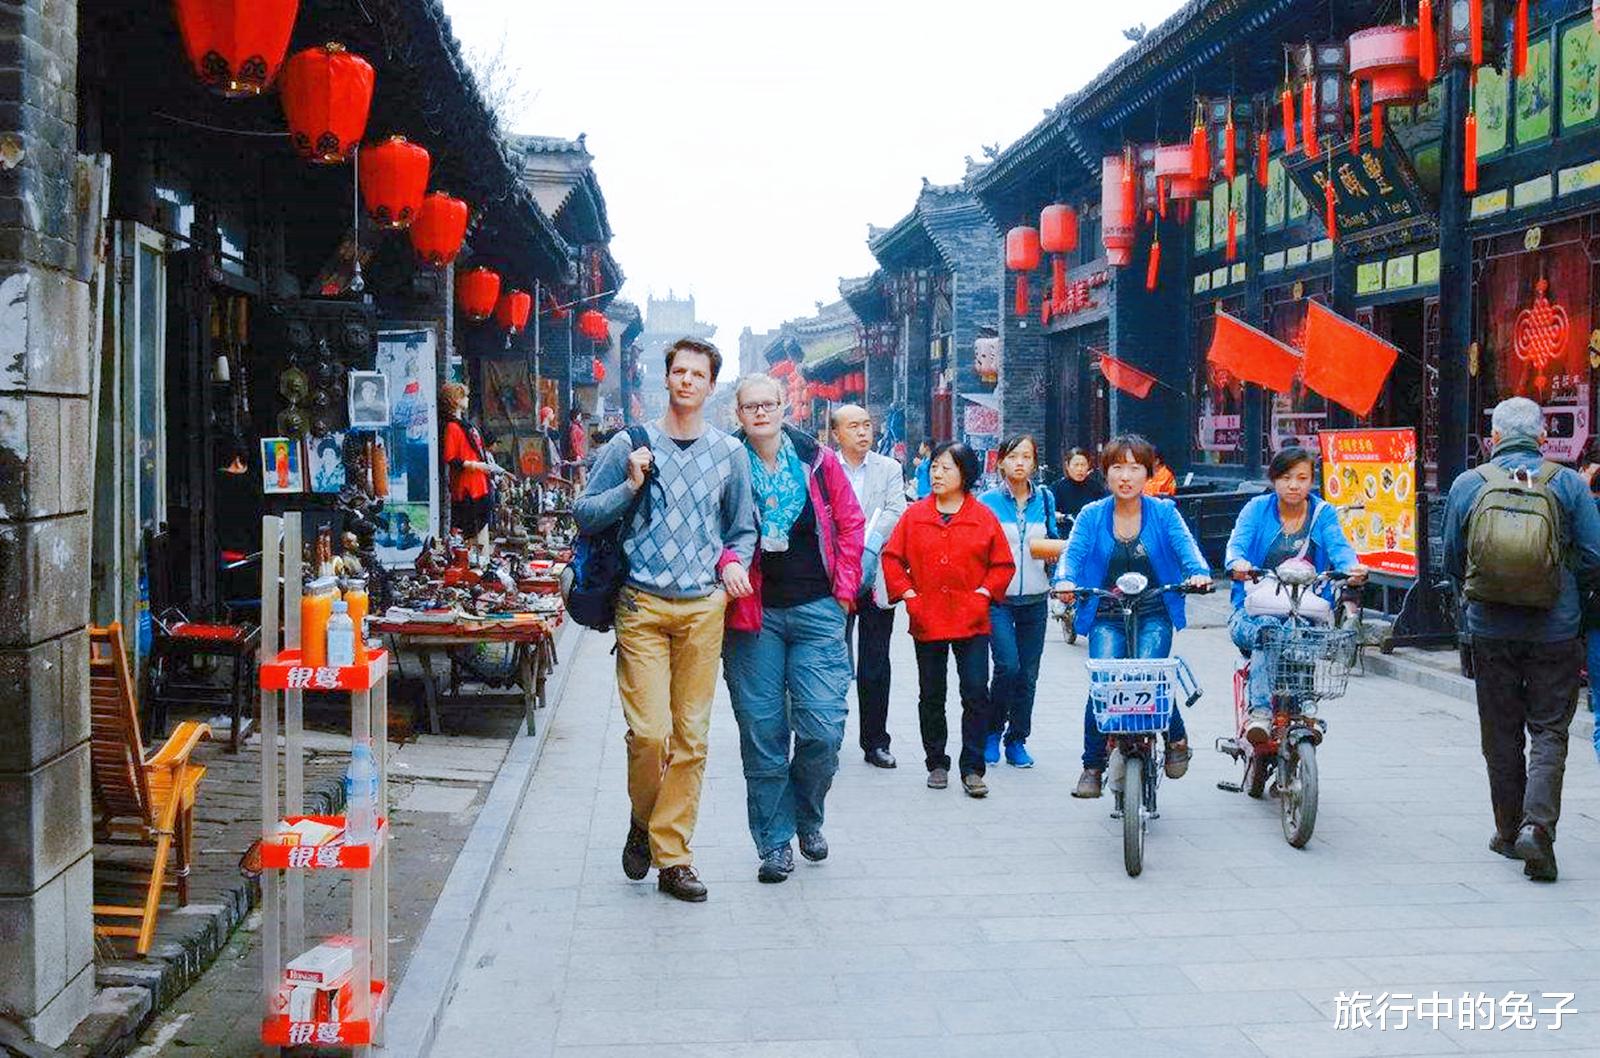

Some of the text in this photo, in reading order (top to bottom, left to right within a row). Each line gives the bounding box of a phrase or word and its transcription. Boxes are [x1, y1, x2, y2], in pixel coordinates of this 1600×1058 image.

[287, 666, 341, 689] 银鹭
[288, 846, 341, 868] 银鹭
[289, 1022, 343, 1044] 银鹭
